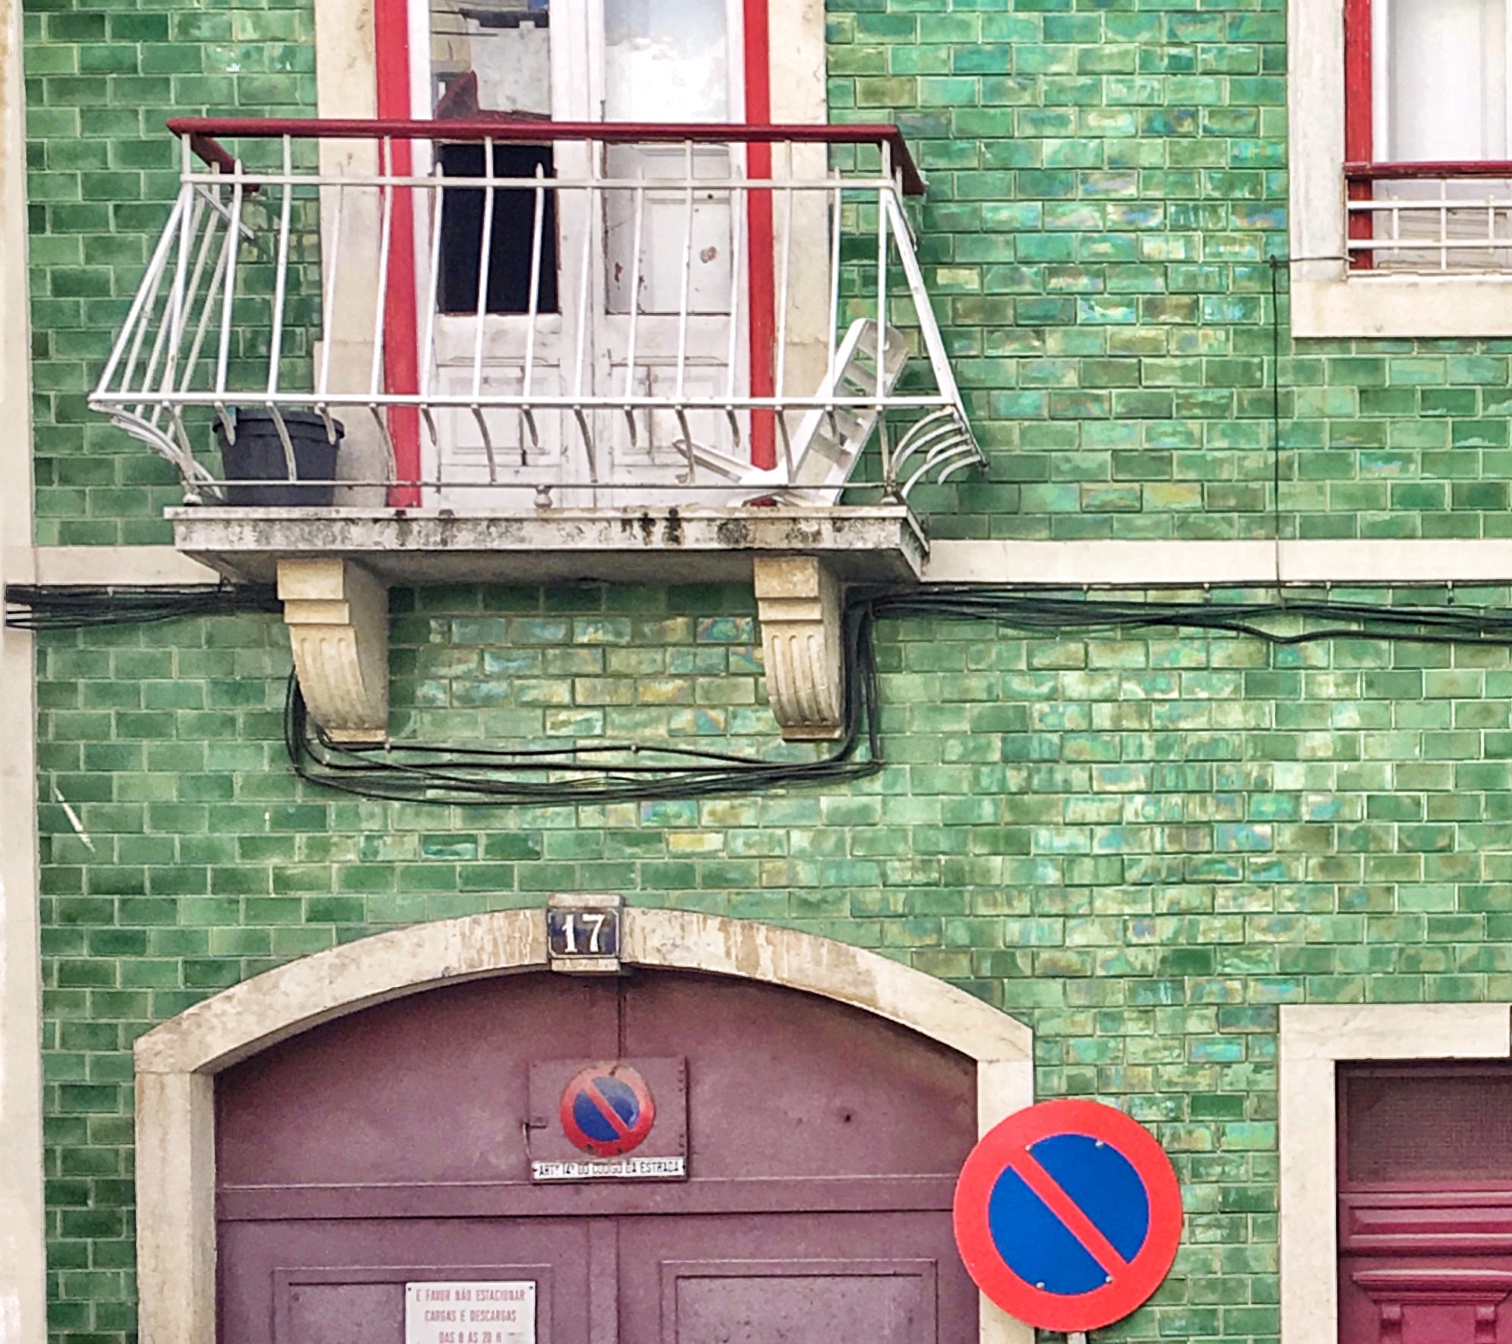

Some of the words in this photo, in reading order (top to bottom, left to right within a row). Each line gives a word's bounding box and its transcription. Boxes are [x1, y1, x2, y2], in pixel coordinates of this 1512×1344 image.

[561, 913, 606, 953] 17
[640, 1161, 679, 1173] ESTRADA
[426, 1289, 451, 1301] FAVOR
[455, 1287, 471, 1301] NÃO
[476, 1289, 525, 1301] ESTACIONAR
[425, 1309, 456, 1322] CARGAS
[460, 1310, 465, 1322] E
[470, 1309, 516, 1322] DESCARGAS
[439, 1331, 455, 1344] DAS
